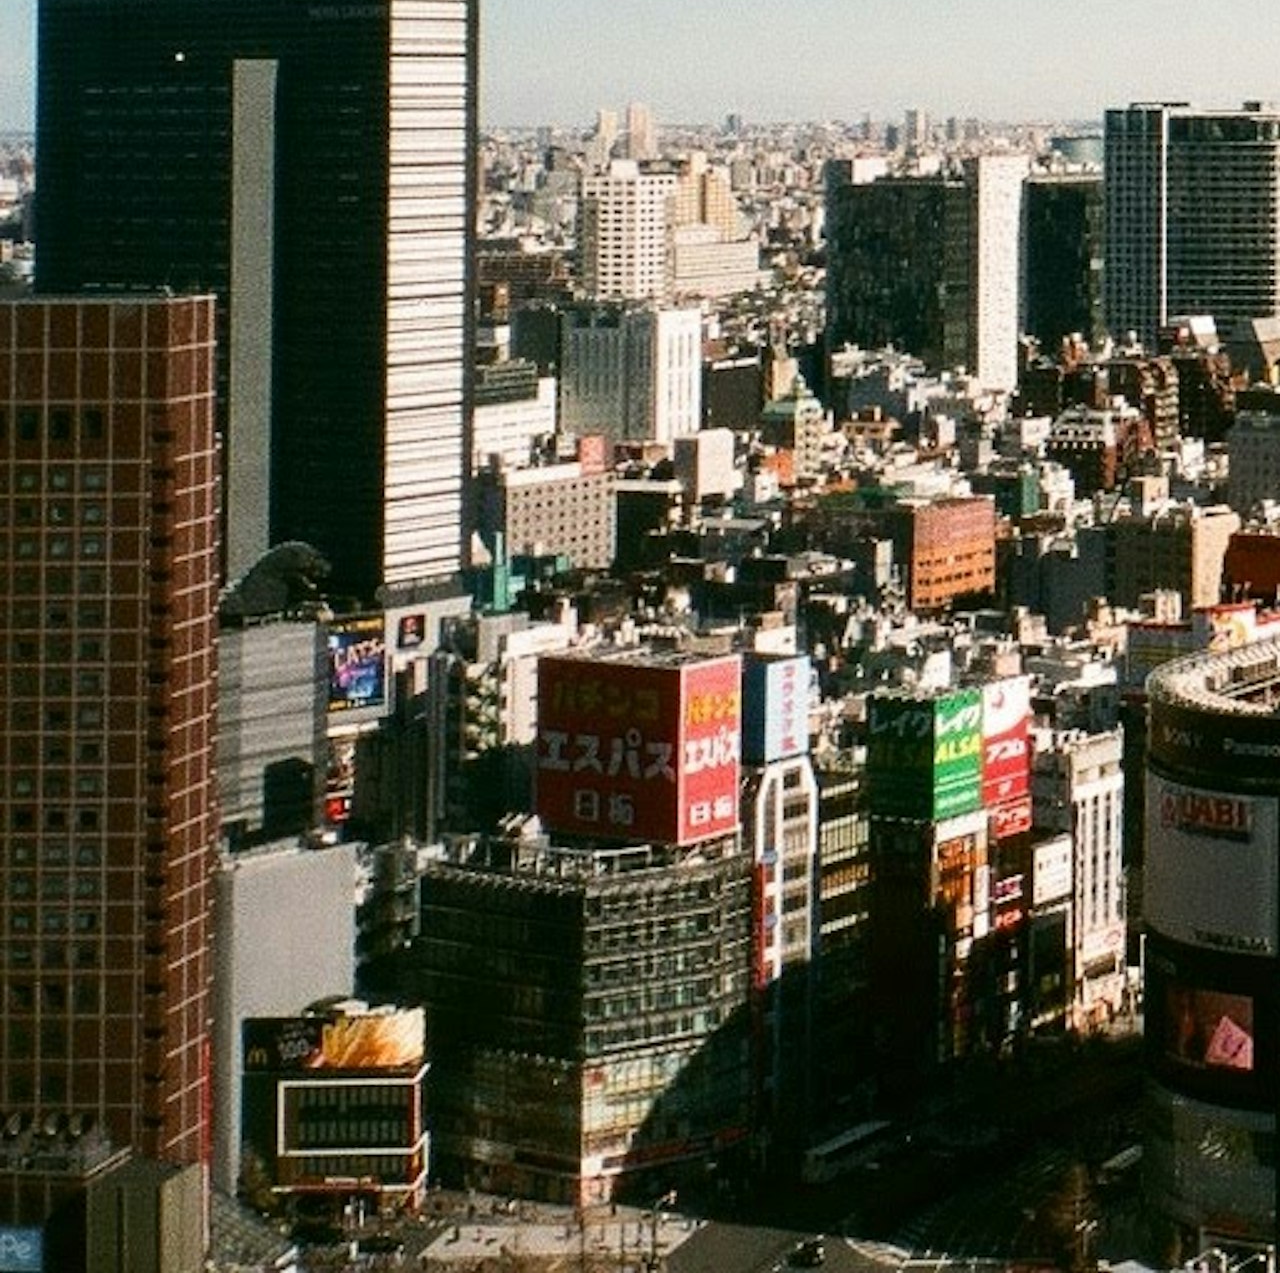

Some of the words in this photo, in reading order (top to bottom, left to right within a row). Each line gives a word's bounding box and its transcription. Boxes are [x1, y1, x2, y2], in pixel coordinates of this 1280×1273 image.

[539, 729, 677, 782] エスパス
[685, 726, 739, 774] エスパス
